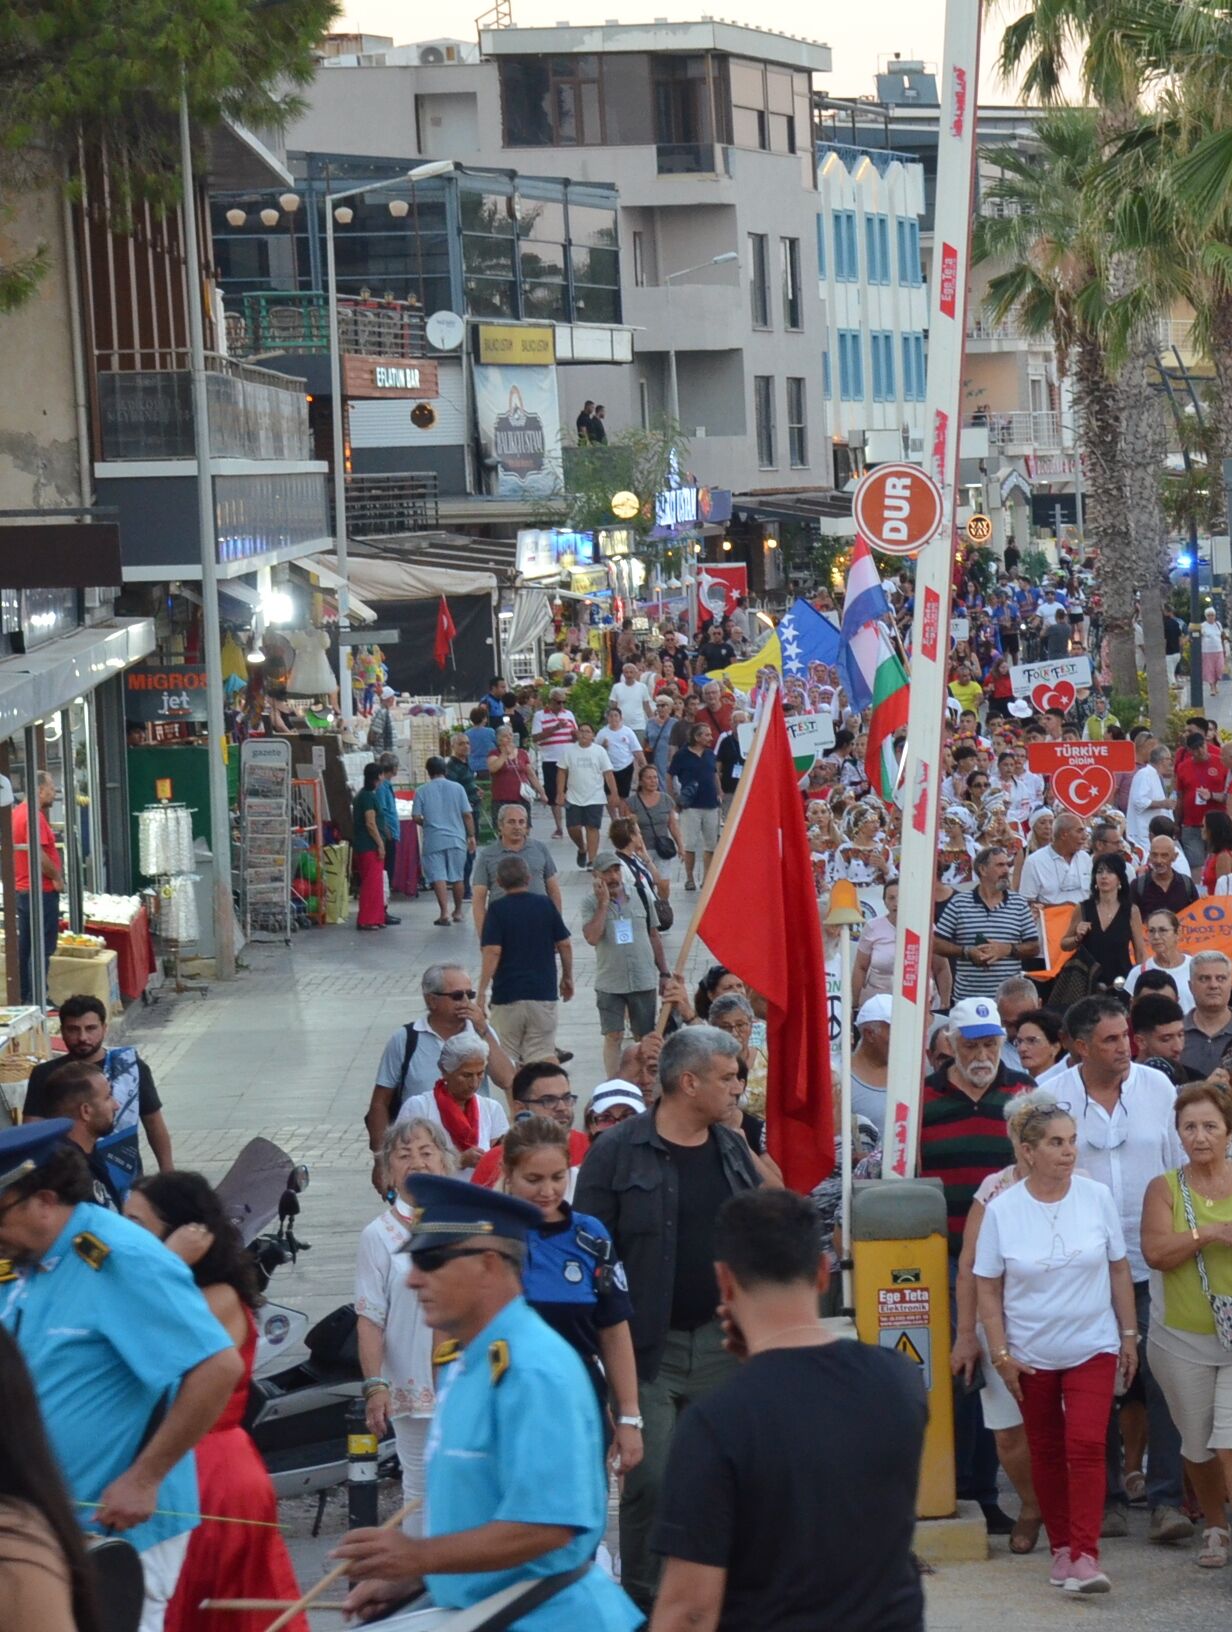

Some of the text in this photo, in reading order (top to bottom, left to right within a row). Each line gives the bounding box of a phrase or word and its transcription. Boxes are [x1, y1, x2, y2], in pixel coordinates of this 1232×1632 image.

[376, 366, 420, 388] EFLATUN BAR
[882, 476, 911, 541] DUR
[160, 691, 190, 712] jet
[252, 749, 282, 760] gazete
[1055, 743, 1109, 757] TÜRKİYE
[1068, 756, 1095, 766] DİDİM
[880, 1288, 928, 1305] Ege Teta
[880, 1303, 927, 1312] Elektronik
